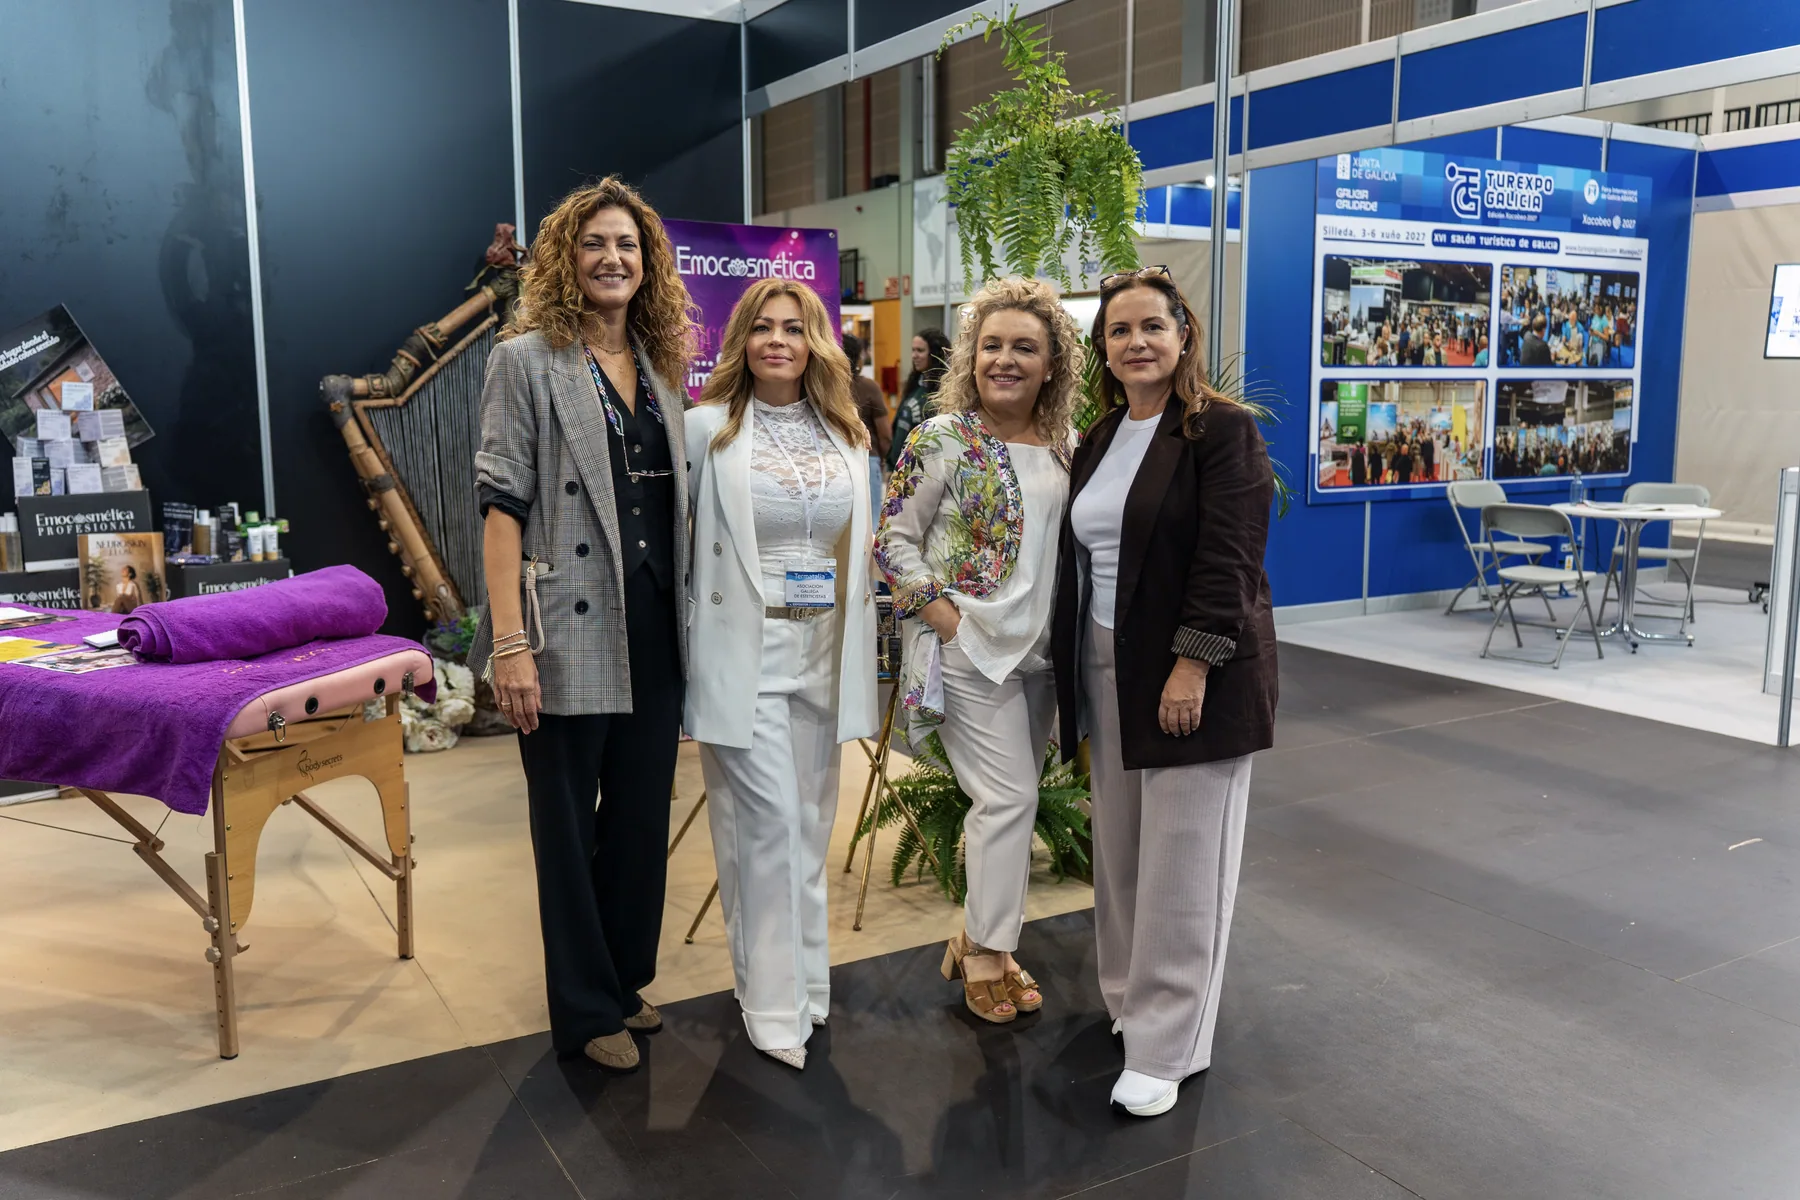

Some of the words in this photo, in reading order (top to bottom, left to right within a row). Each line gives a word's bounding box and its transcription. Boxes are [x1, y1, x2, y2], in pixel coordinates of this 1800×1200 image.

[1353, 157, 1380, 169] XUNTA
[1352, 168, 1363, 179] DE
[1365, 169, 1397, 181] GALICIA
[1486, 171, 1553, 193] TUREXPO
[1486, 190, 1541, 210] GALICIA
[1582, 213, 1611, 227] Xacobeo
[1323, 226, 1356, 237] Silleda,
[1361, 228, 1376, 238] 3-6
[676, 245, 815, 280] Emocosmética
[37, 521, 135, 536] PROFESIONAL
